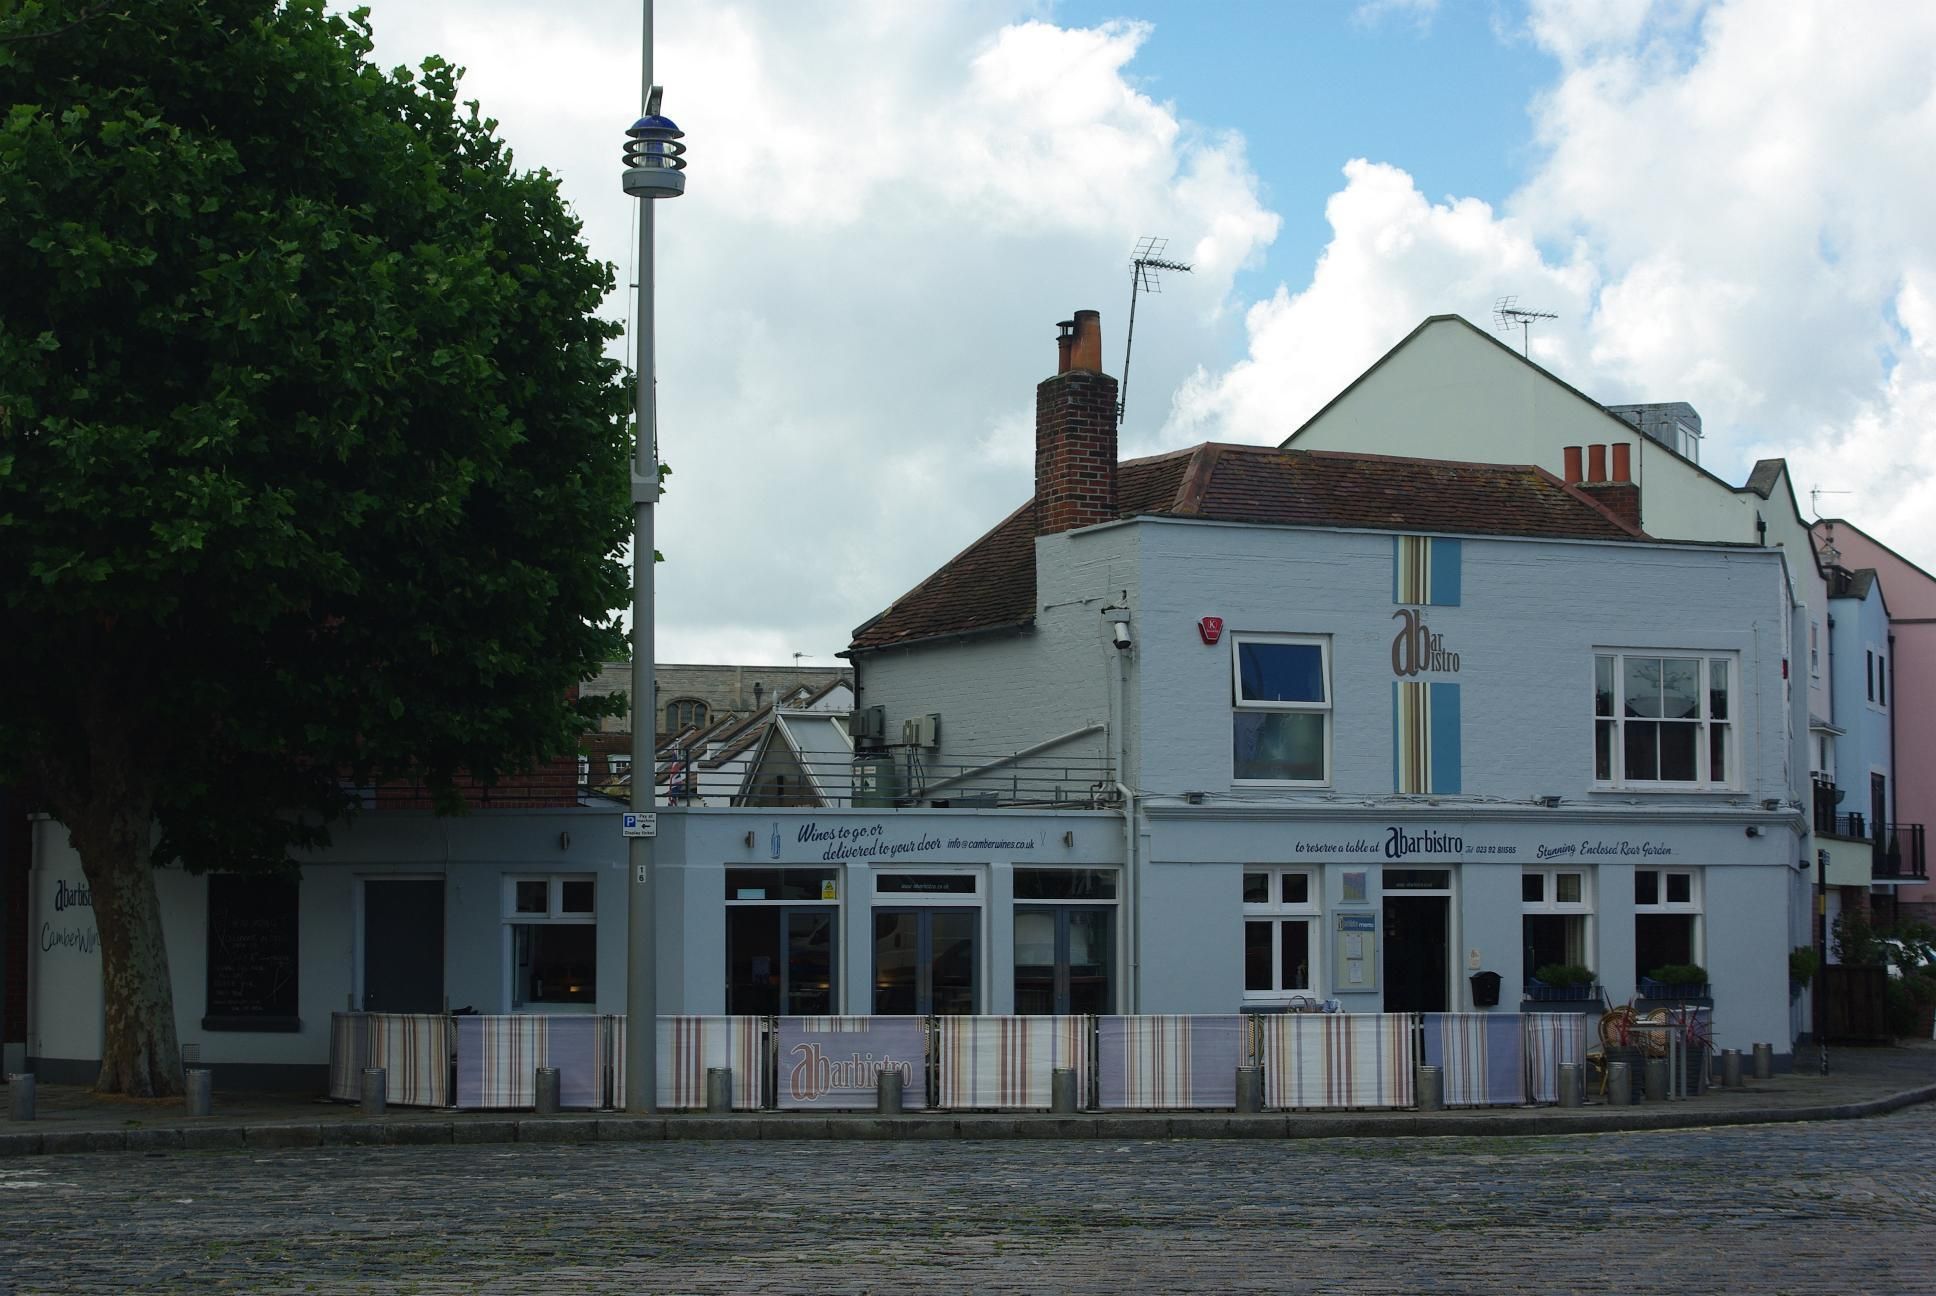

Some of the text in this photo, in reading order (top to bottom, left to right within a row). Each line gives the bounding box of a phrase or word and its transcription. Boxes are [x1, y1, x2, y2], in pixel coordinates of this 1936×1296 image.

[627, 816, 635, 827] P
[797, 822, 835, 843] Wines
[838, 826, 850, 839] to
[822, 833, 941, 860] delivered to your door
[1295, 839, 1380, 853] to reserve a table at
[1475, 846, 1487, 854] 023
[1488, 846, 1496, 854] 92
[1536, 843, 1576, 859] Stunning
[1580, 840, 1619, 856] Enclosed
[1620, 841, 1640, 856] Rear
[55, 879, 93, 911] abarbist
